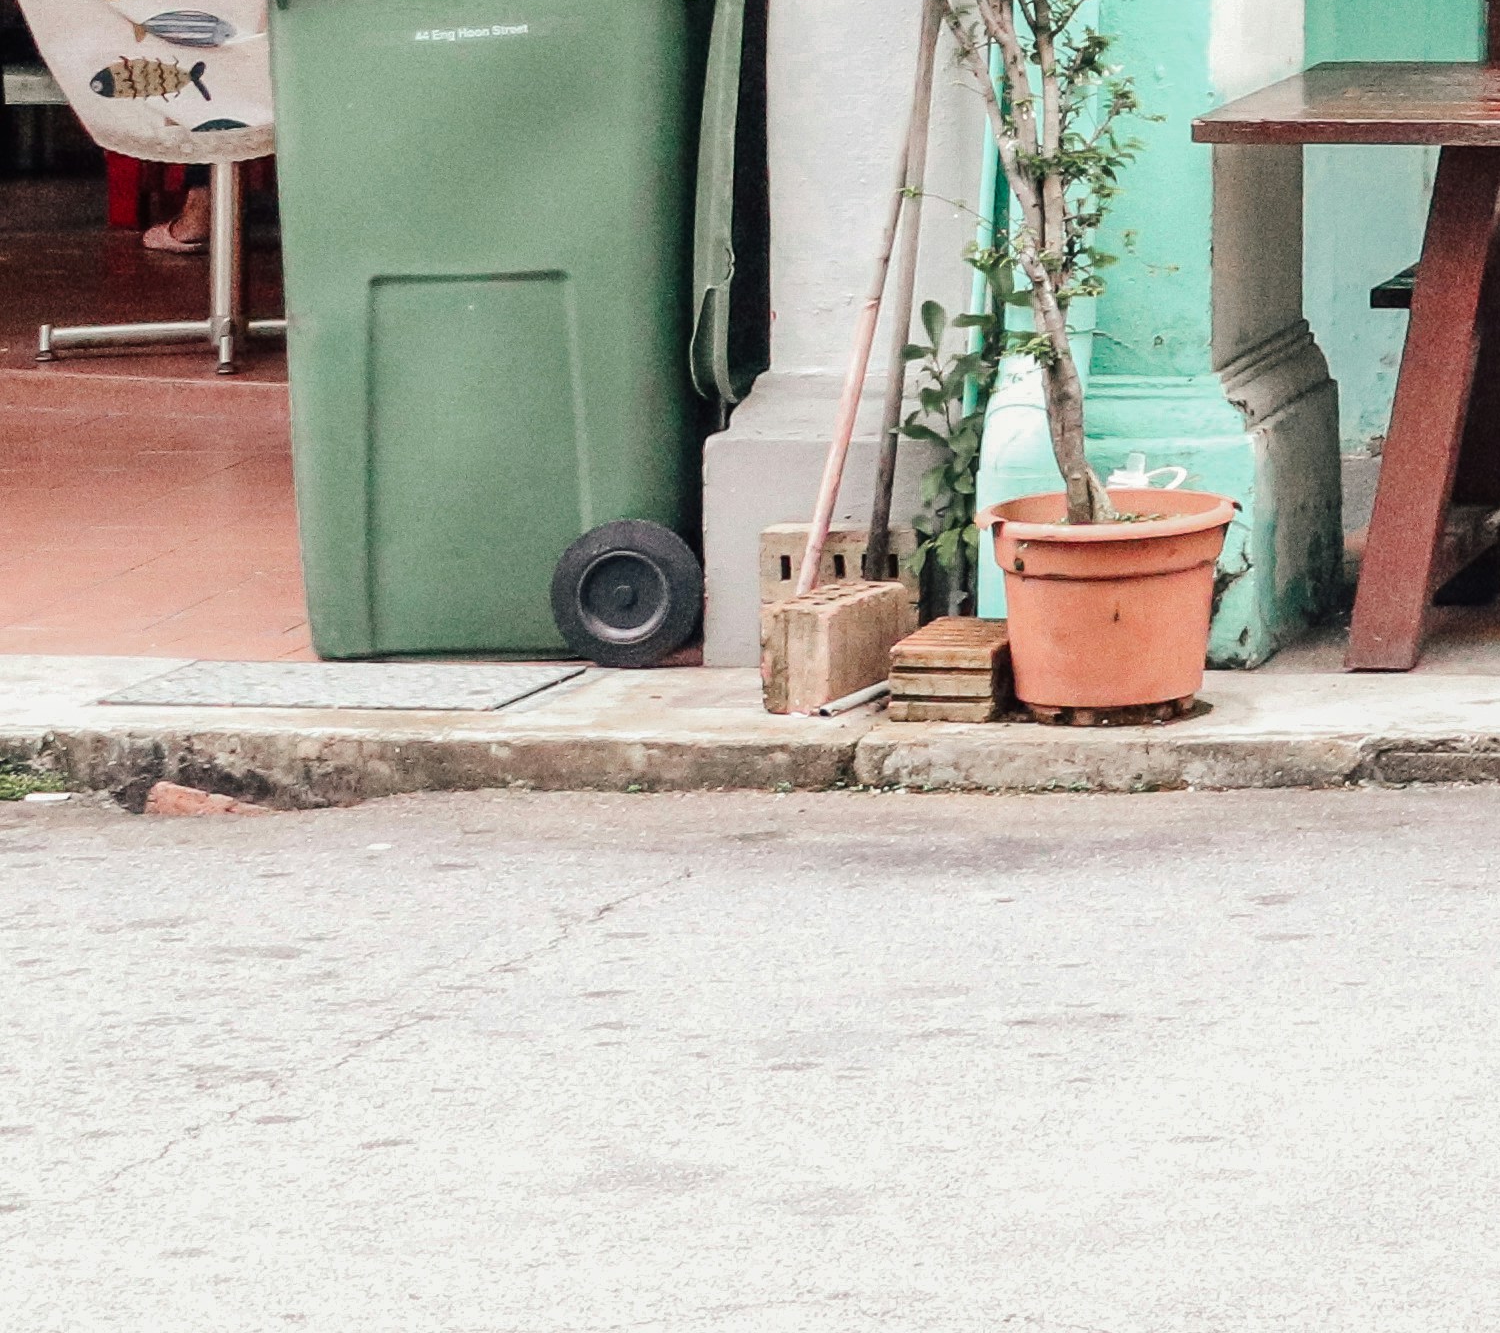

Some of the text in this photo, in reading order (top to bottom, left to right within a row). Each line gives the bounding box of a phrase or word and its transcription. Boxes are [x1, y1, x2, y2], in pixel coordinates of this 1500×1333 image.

[431, 29, 456, 42] Eng
[458, 27, 490, 38] Hoon
[491, 23, 529, 36] Street
